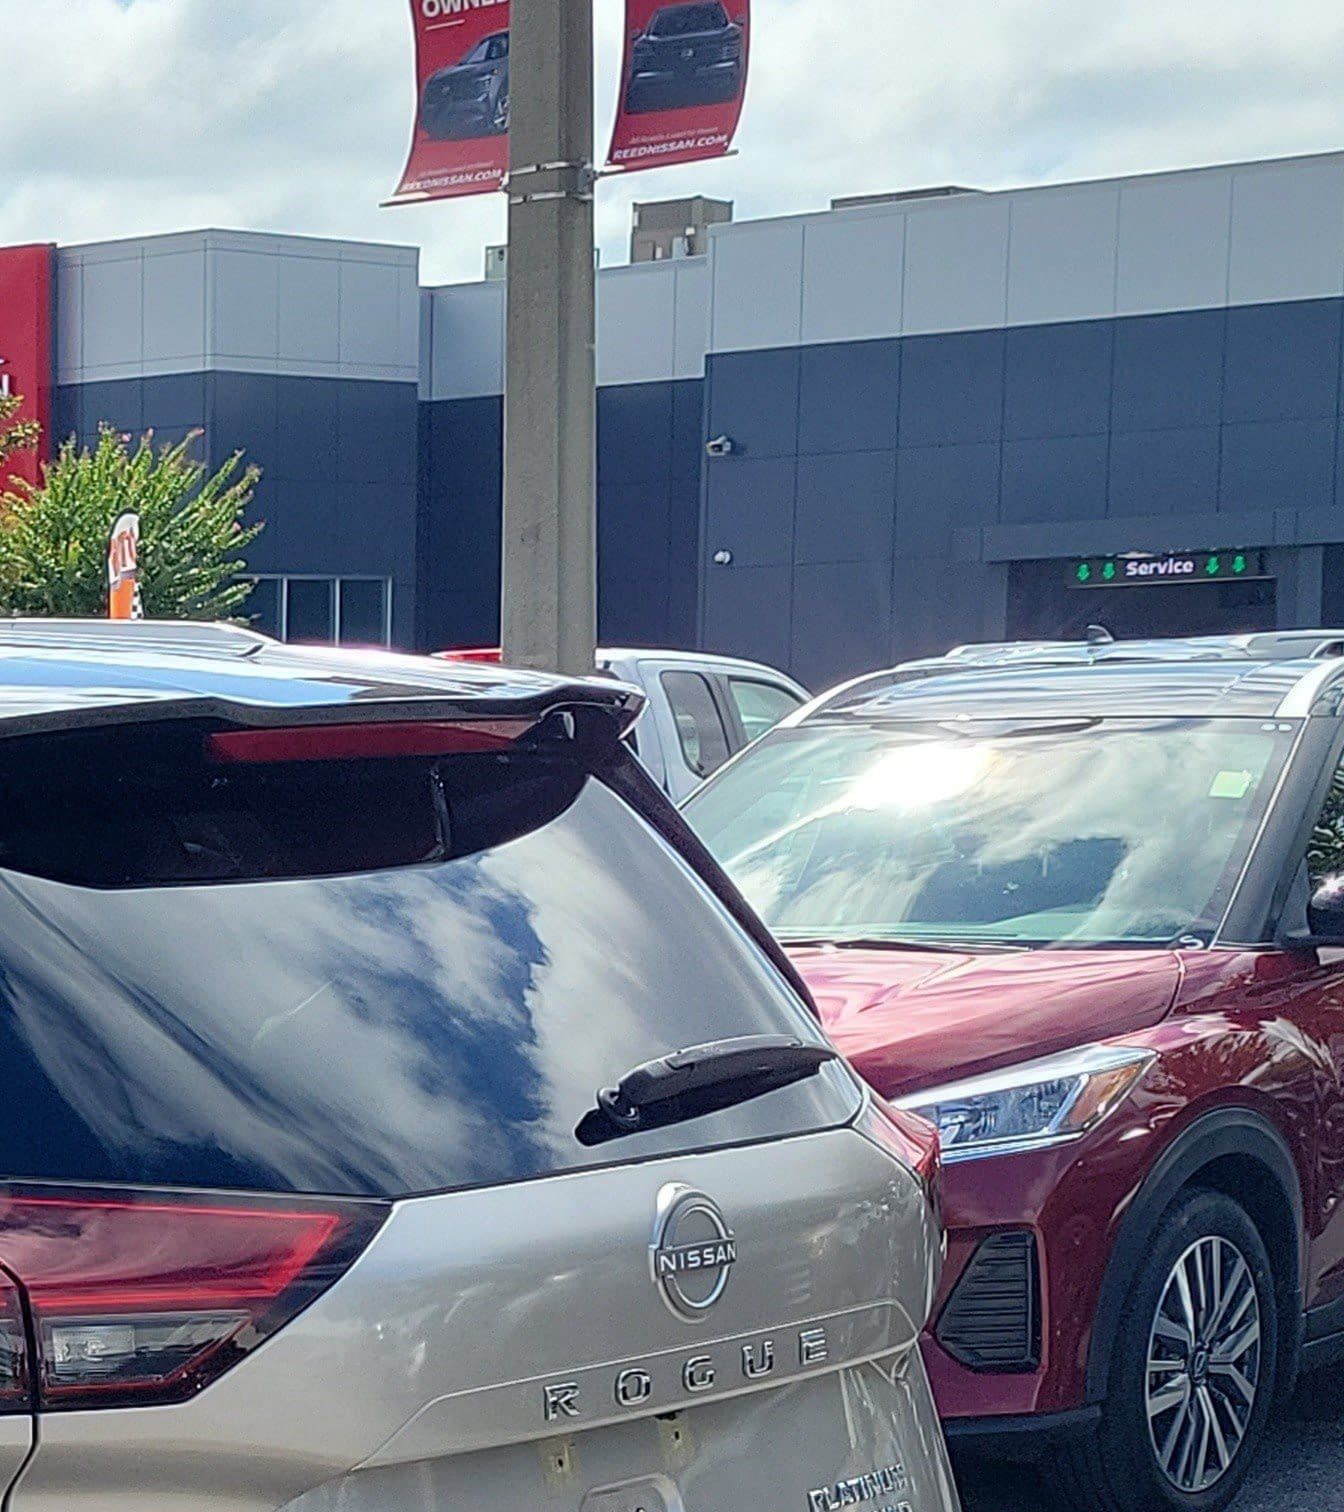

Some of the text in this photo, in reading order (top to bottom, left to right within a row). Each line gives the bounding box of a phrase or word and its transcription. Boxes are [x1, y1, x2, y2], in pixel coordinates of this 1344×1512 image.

[1126, 559, 1194, 577] Service
[660, 1242, 736, 1273] NISSAN
[543, 1328, 828, 1421] ROGUE
